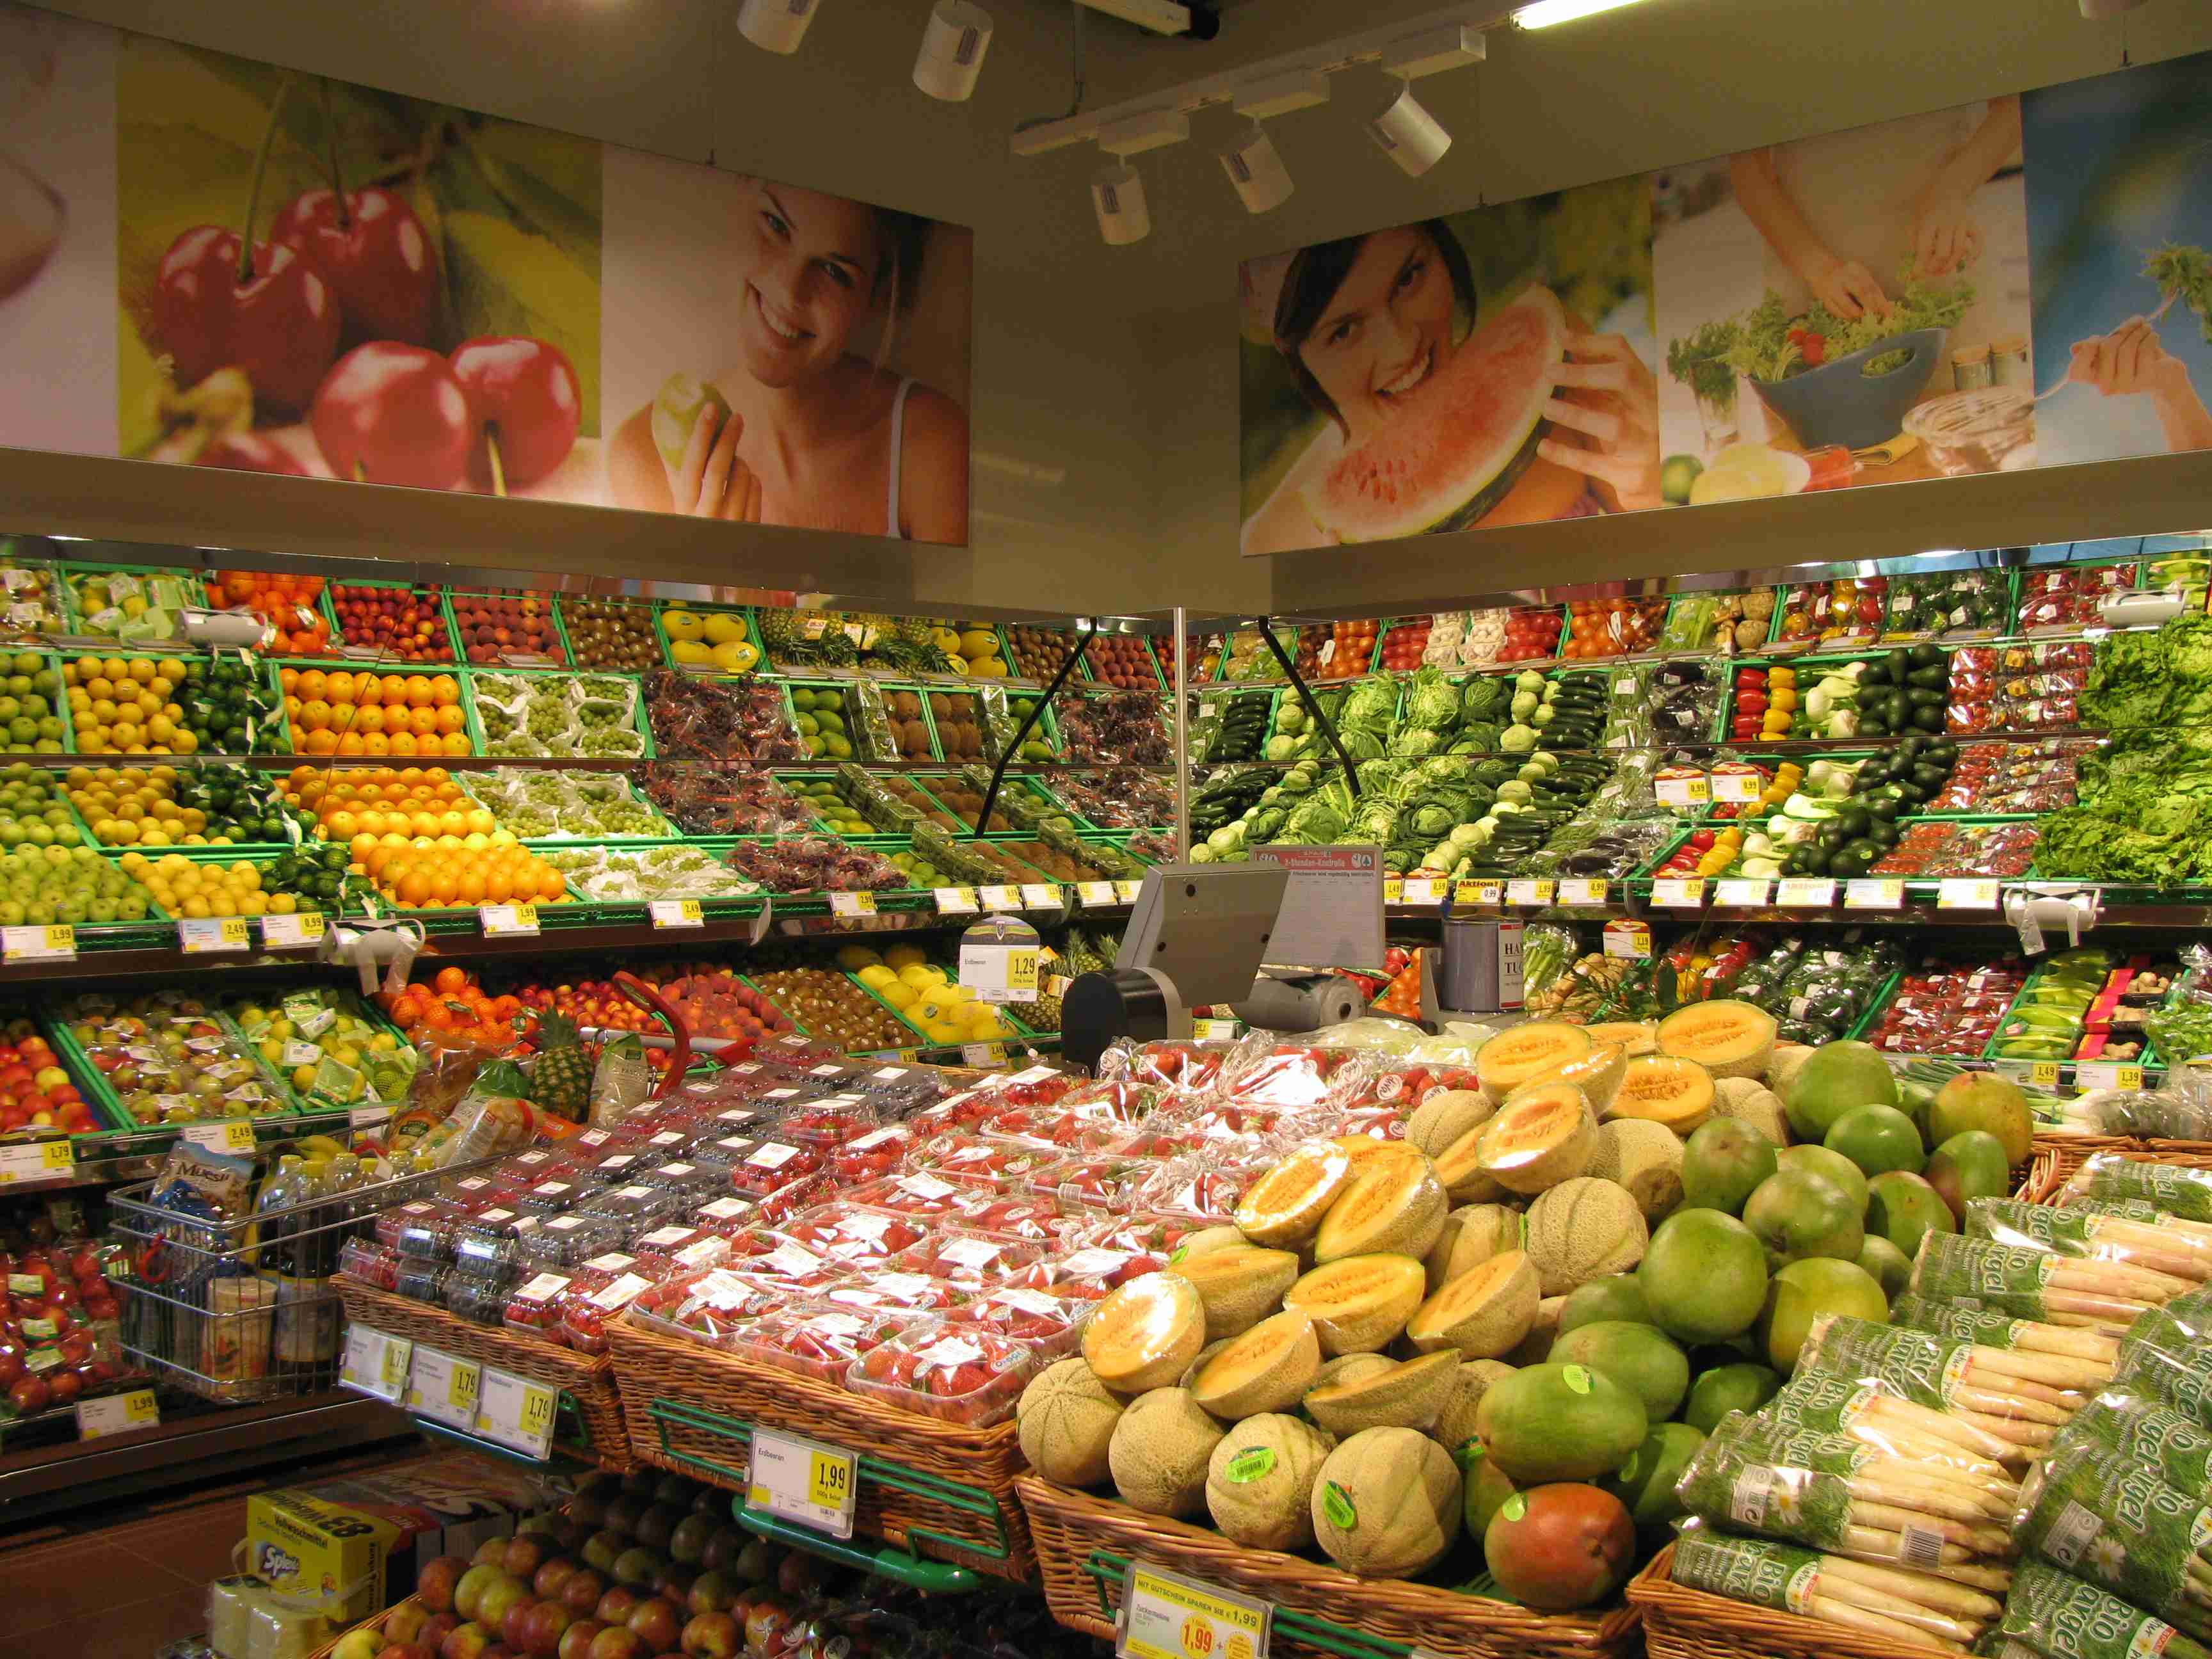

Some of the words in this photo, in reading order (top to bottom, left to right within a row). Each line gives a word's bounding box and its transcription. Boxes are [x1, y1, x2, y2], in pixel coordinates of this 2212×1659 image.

[226, 923, 244, 935] 2,49
[304, 917, 322, 928] 0,99
[51, 928, 72, 941] 1,99
[1014, 957, 1036, 977] 1,29
[2037, 1066, 2055, 1077] 1,49
[2121, 1072, 2139, 1084] 1,39
[231, 1126, 252, 1139] 2,49
[51, 1145, 70, 1160] 1,79
[458, 1371, 476, 1394] 1,79
[132, 1394, 155, 1411] 1,99
[1807, 1379, 1848, 1410] Bio
[529, 1395, 549, 1420] 1,79
[818, 1461, 846, 1490] 1,99
[1751, 1559, 1787, 1601] Bio
[1233, 1608, 1258, 1627] 1,99
[2089, 1596, 2136, 1642] Bio
[1183, 1623, 1213, 1653] 1,99
